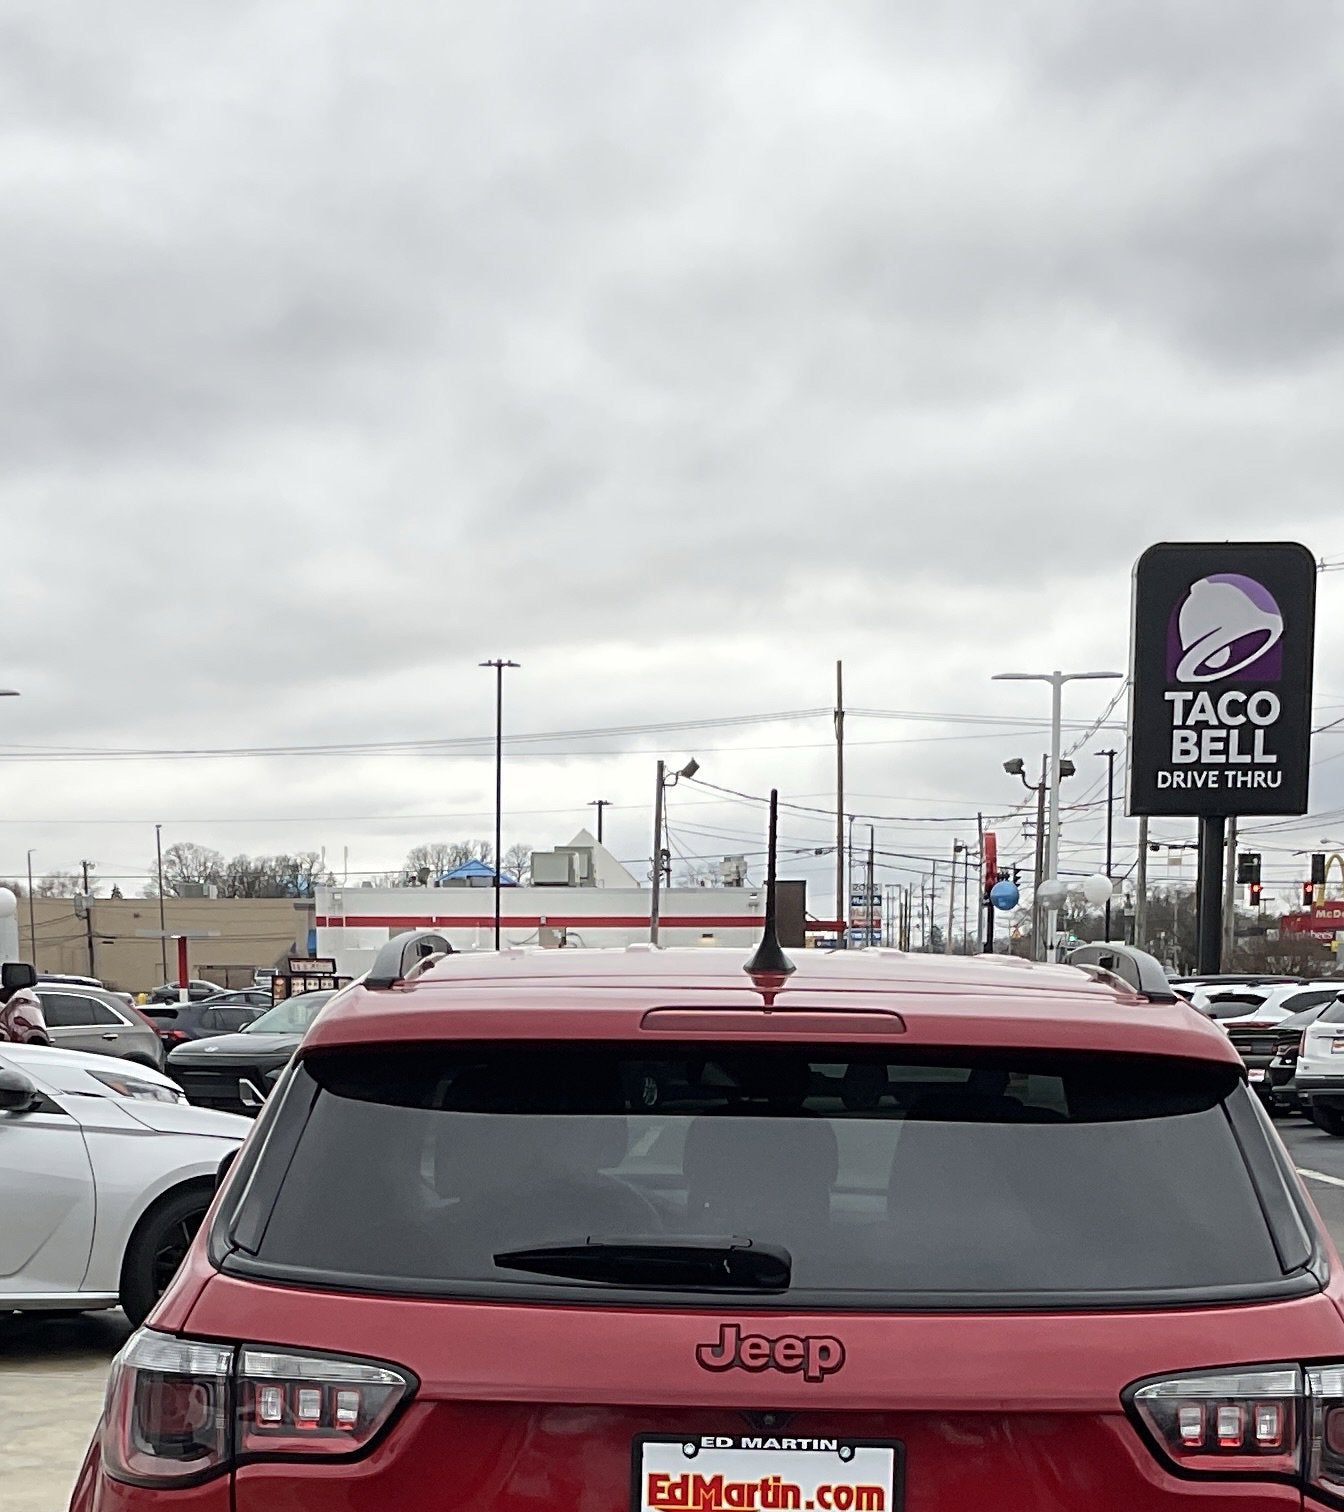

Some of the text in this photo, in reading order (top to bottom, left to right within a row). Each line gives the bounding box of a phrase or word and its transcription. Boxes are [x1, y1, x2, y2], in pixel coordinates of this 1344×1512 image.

[1164, 691, 1281, 726] TACO
[1171, 729, 1277, 764] BELL
[1157, 770, 1282, 788] DRIVE THRU
[696, 1323, 846, 1382] Jeep
[701, 1437, 838, 1450] ED MARTIN
[648, 1473, 886, 1512] EdMartin.com
